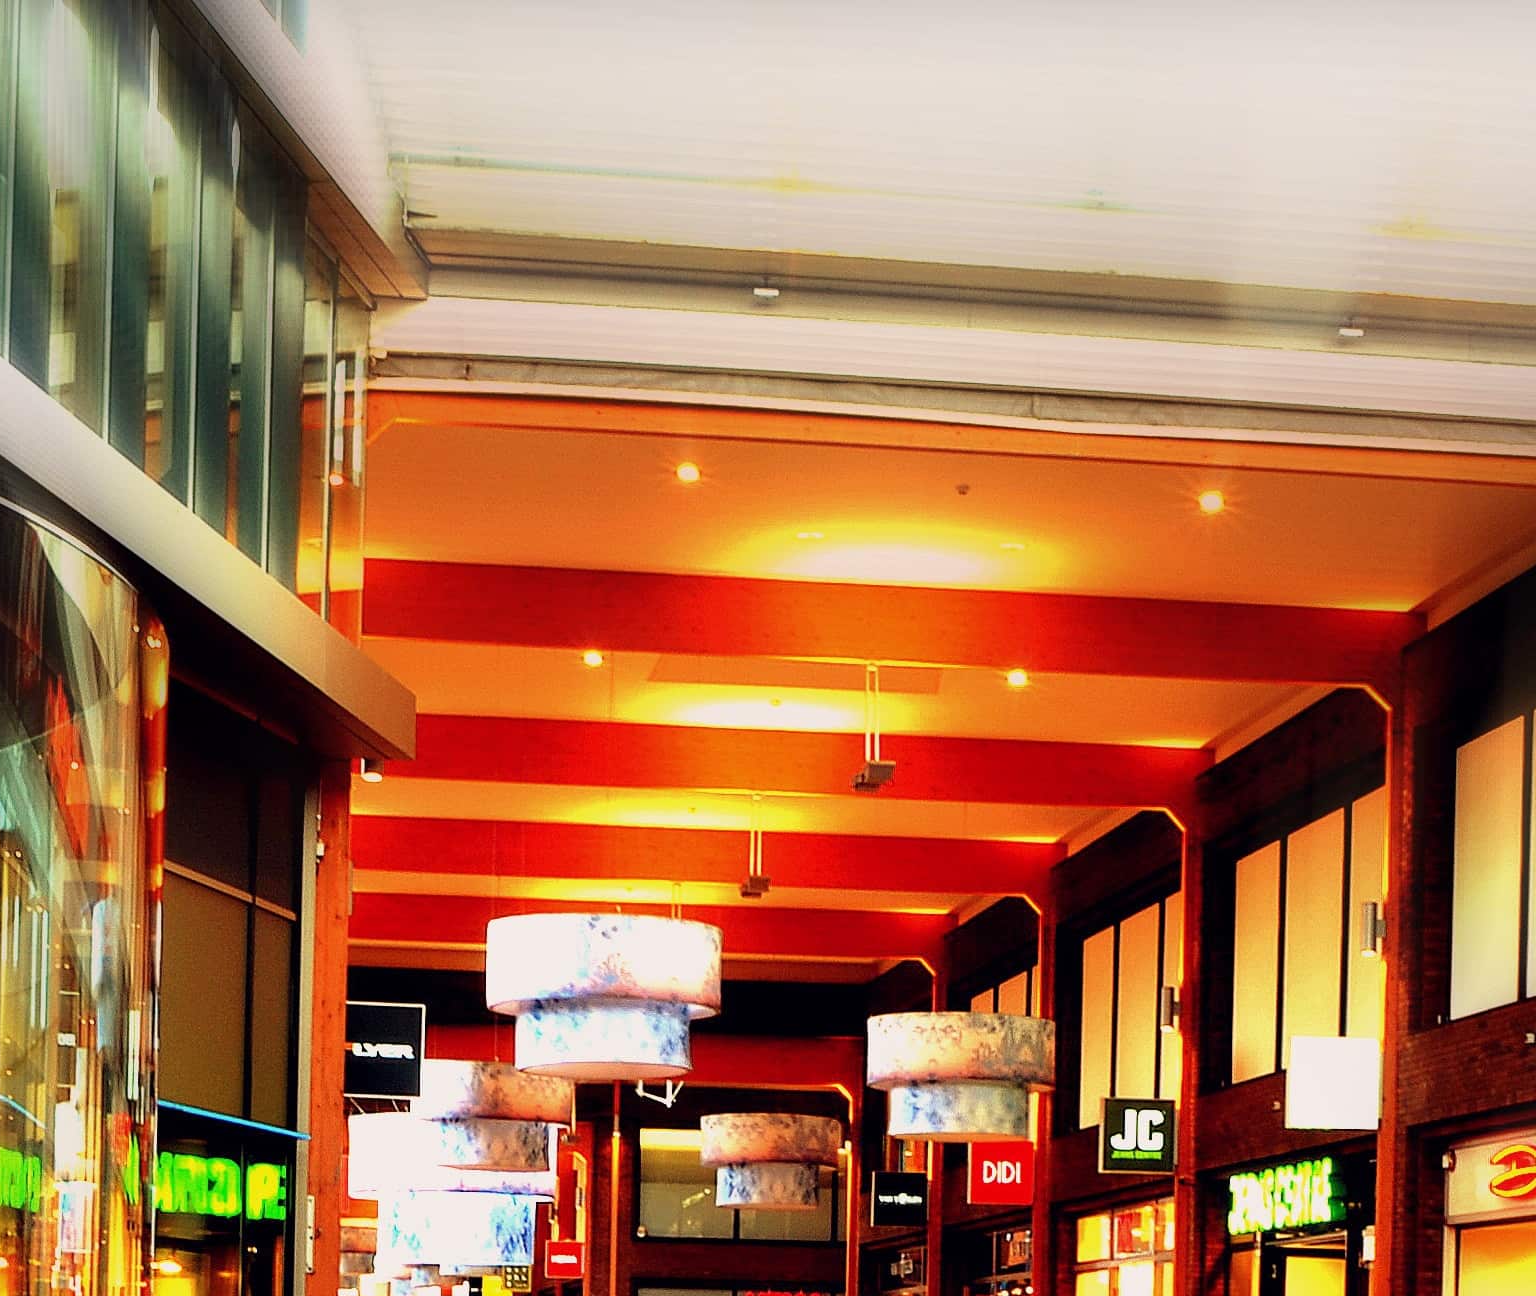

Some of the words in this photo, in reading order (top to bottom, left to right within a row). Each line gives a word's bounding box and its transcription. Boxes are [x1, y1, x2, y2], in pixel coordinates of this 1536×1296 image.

[346, 1041, 416, 1060] LYER
[1110, 1108, 1165, 1151] JC
[982, 1160, 1021, 1184] DIDI
